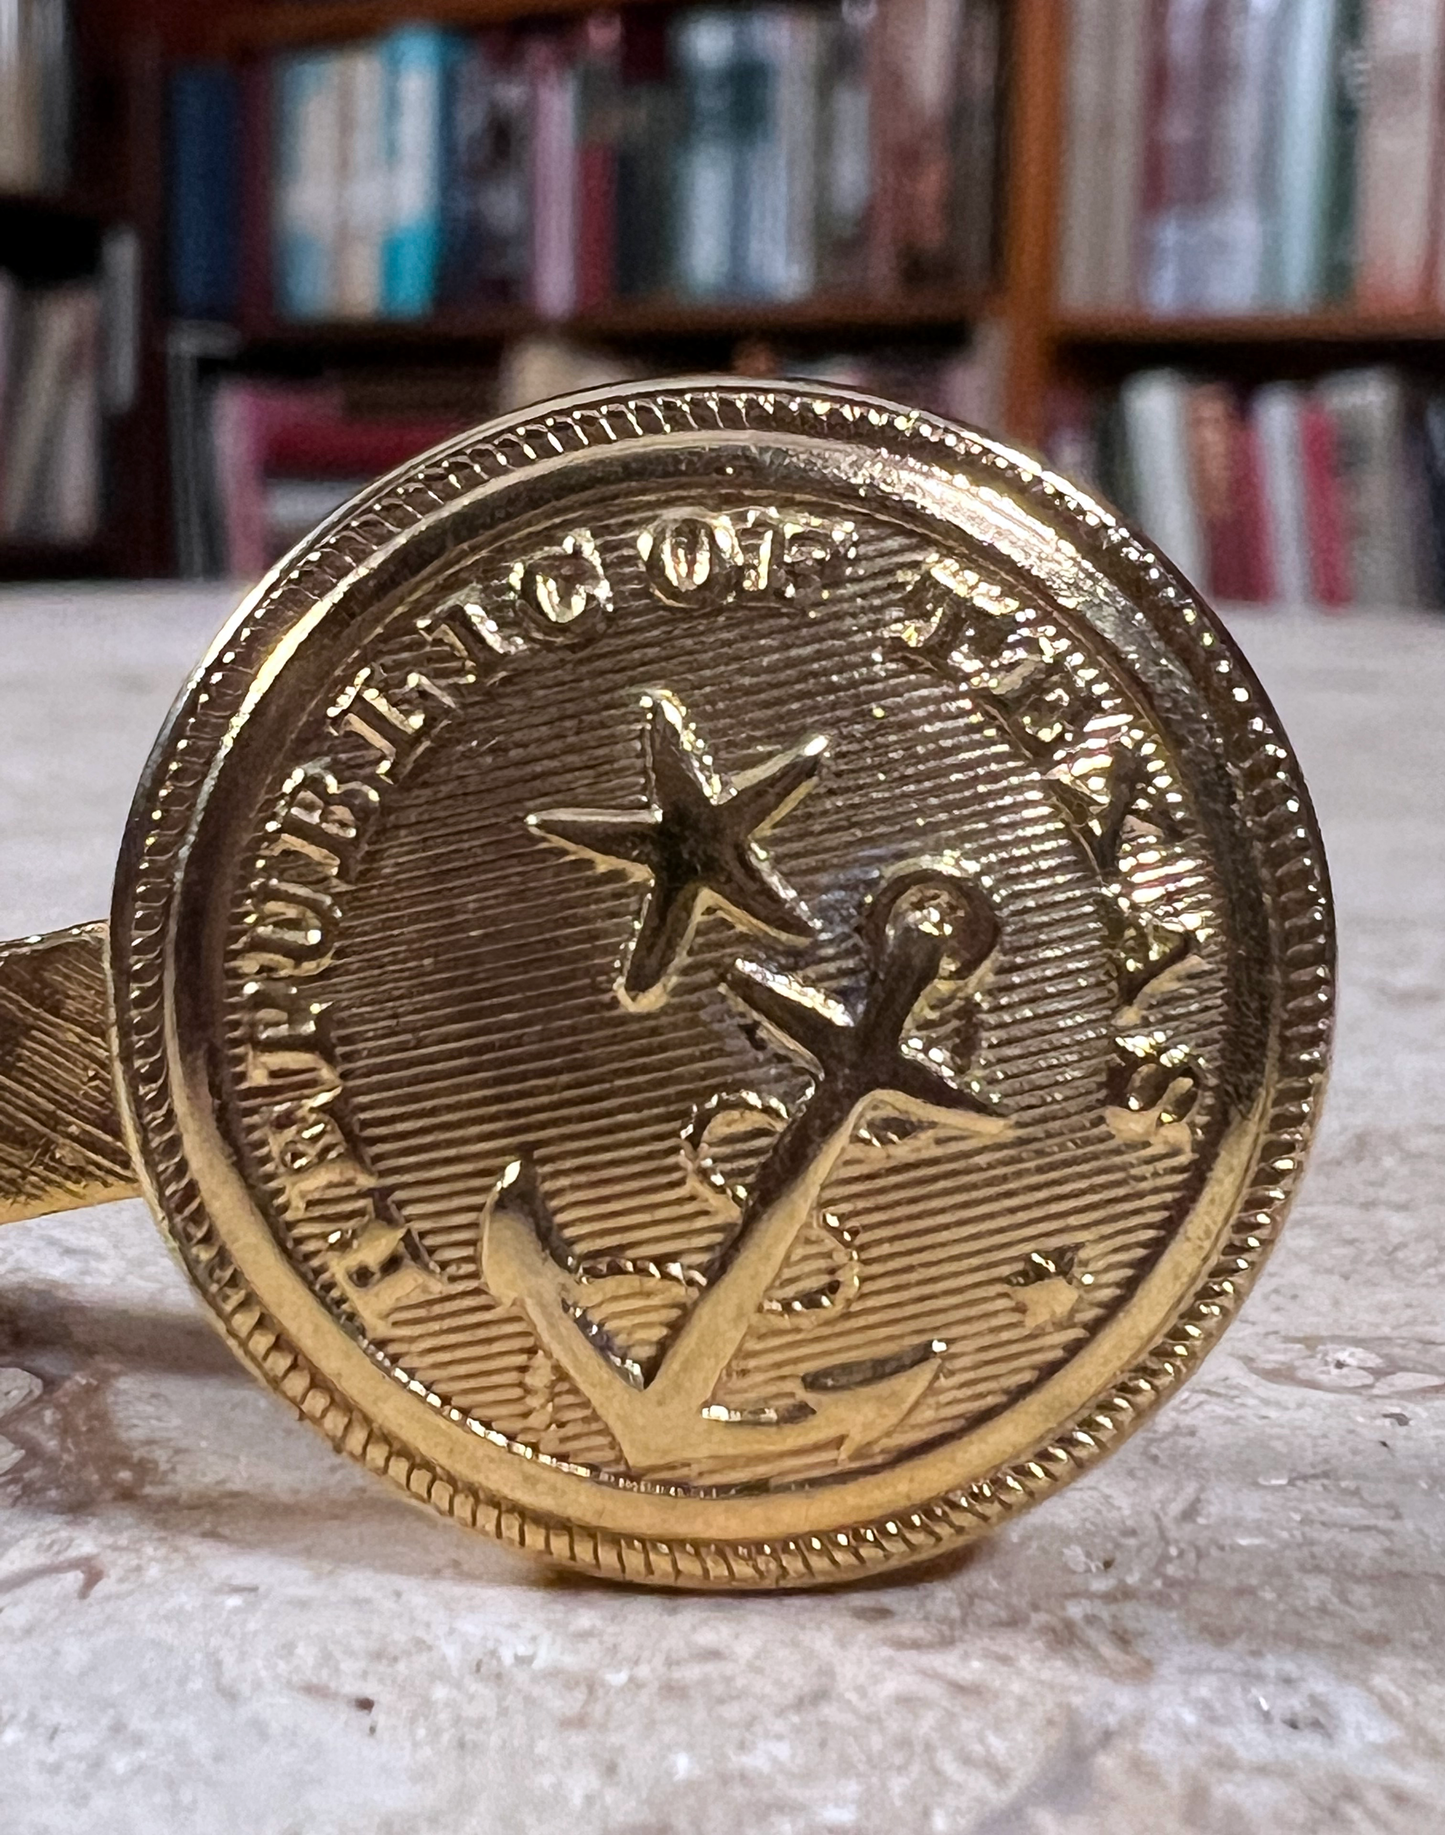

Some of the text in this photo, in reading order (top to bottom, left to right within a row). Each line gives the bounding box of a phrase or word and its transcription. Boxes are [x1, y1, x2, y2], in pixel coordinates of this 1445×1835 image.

[229, 505, 1208, 1340] REPUBLIC OF TEXAS
